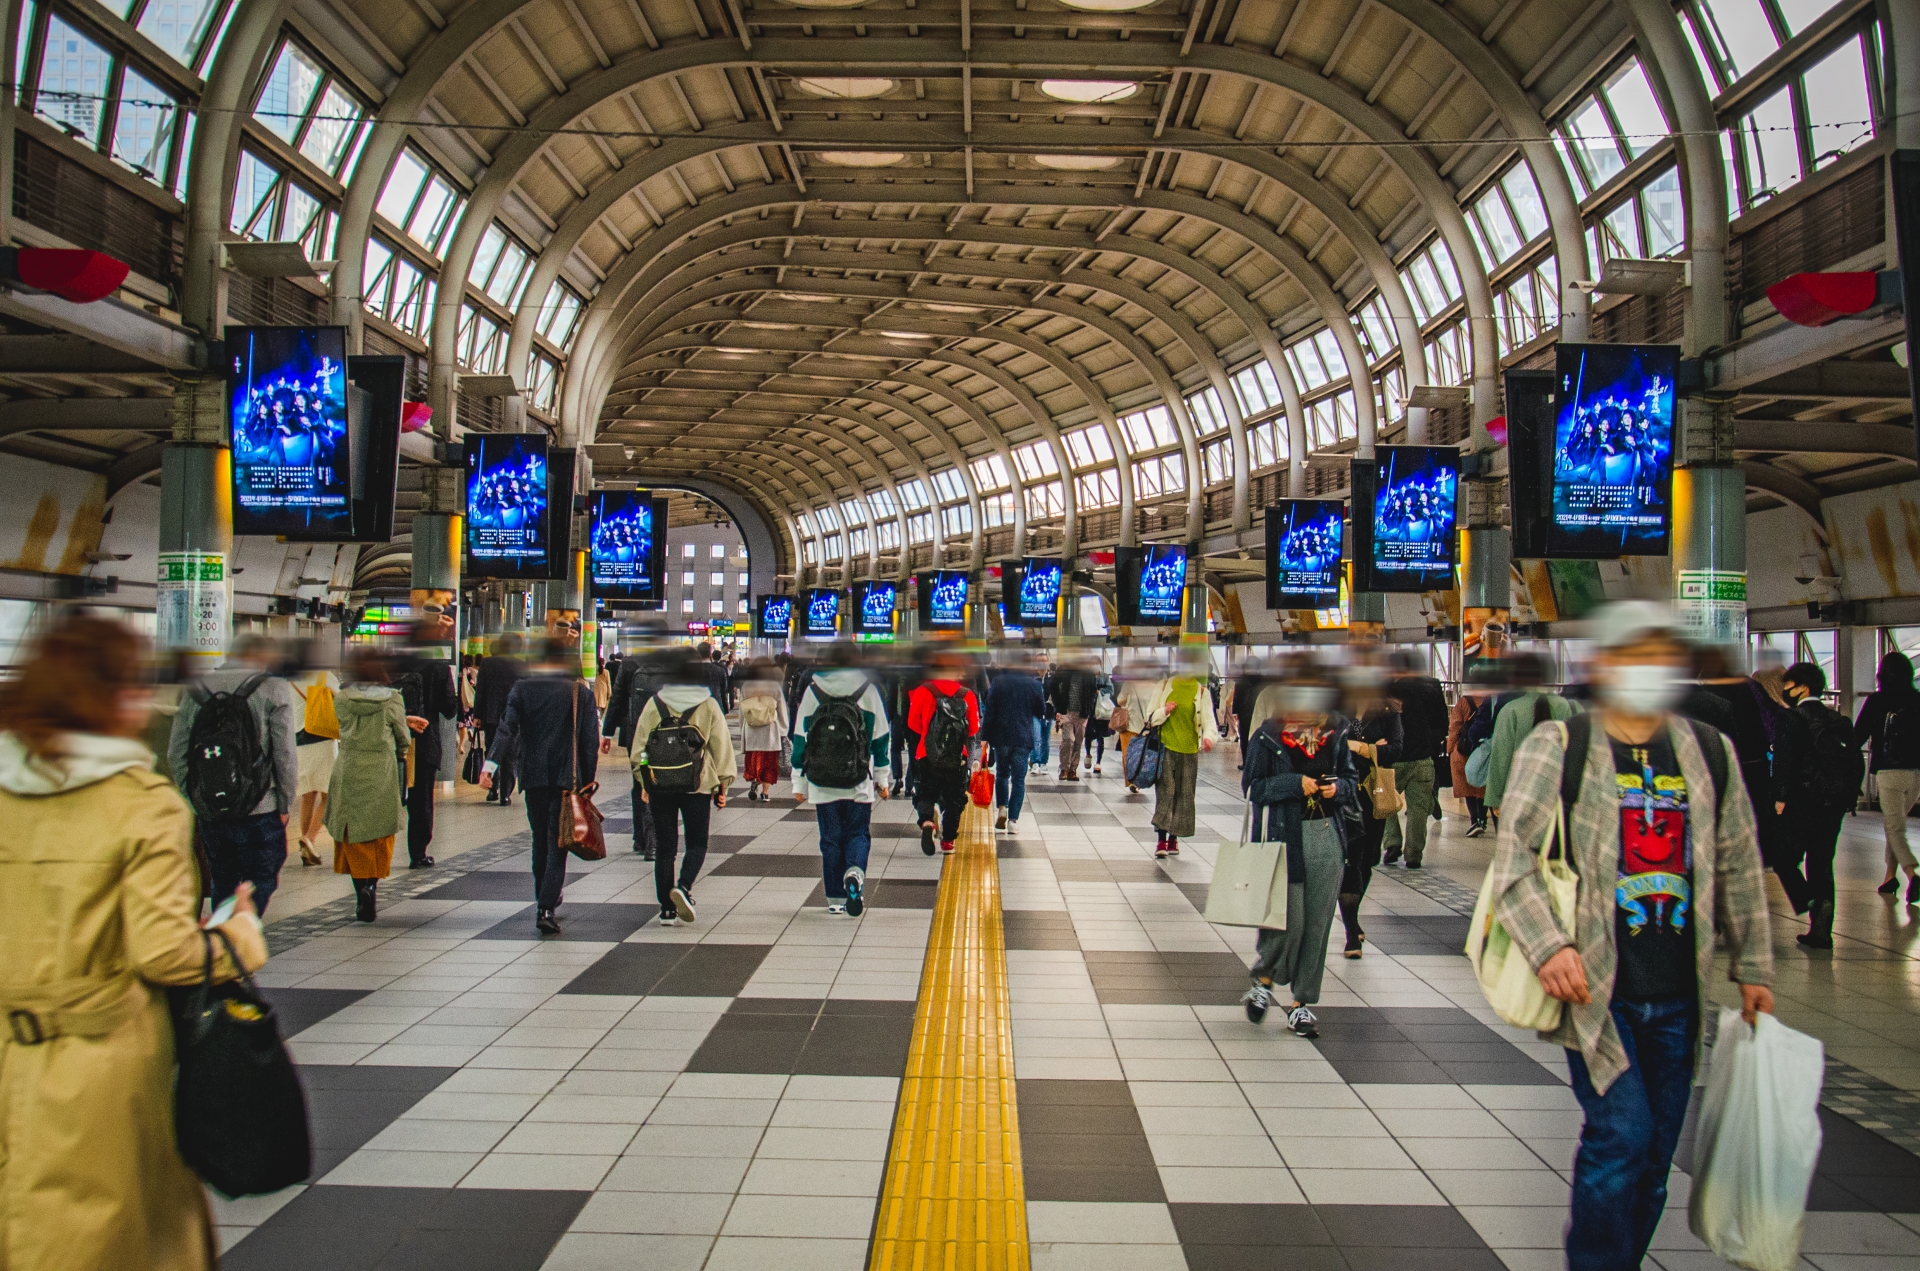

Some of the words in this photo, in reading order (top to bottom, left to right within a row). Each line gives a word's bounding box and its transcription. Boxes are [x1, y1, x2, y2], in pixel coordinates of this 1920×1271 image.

[170, 572, 221, 580] サースご案内
[195, 637, 219, 646] 10:00
